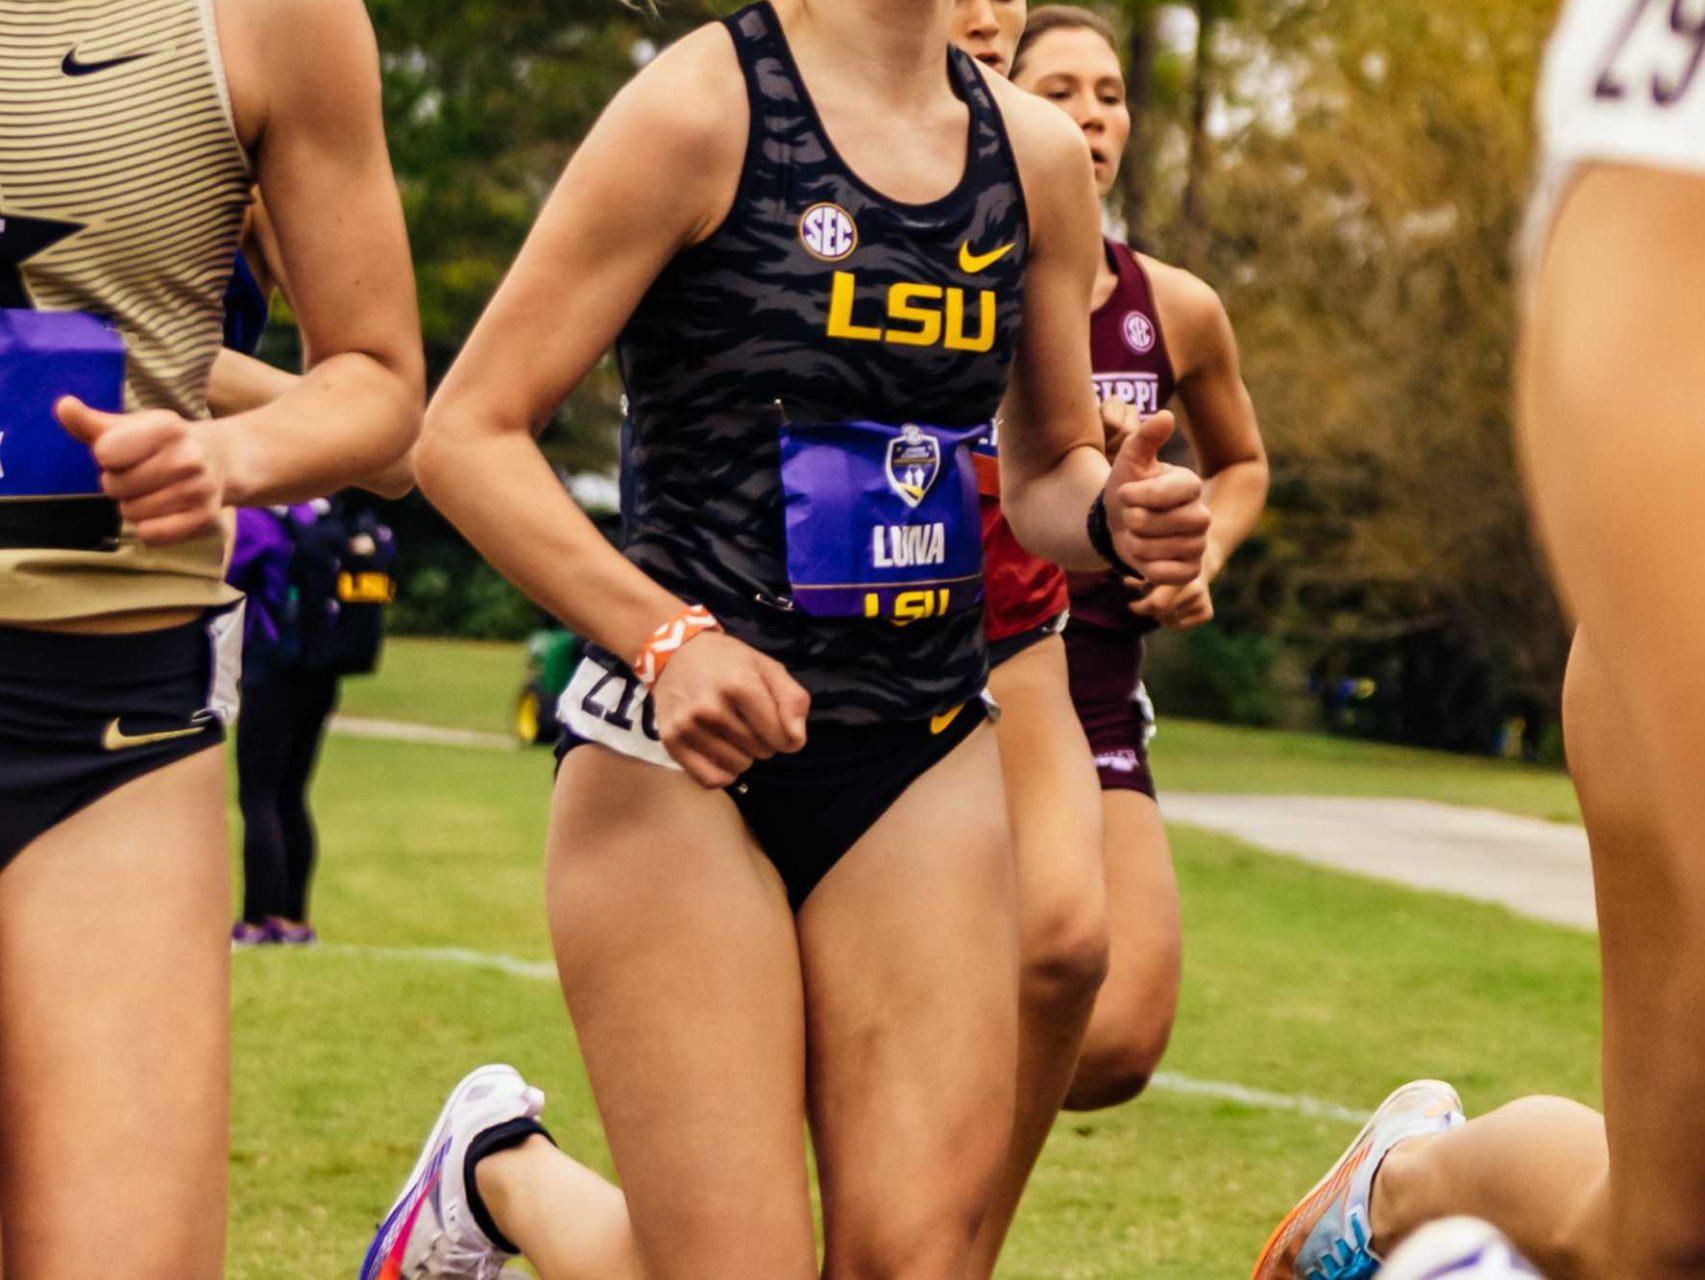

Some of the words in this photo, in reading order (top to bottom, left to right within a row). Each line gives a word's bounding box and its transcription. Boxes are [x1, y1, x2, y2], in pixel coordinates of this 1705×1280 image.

[803, 206, 852, 257] SEC
[826, 270, 996, 352] LSU
[1128, 315, 1151, 348] SEC
[872, 522, 946, 568] LUNA
